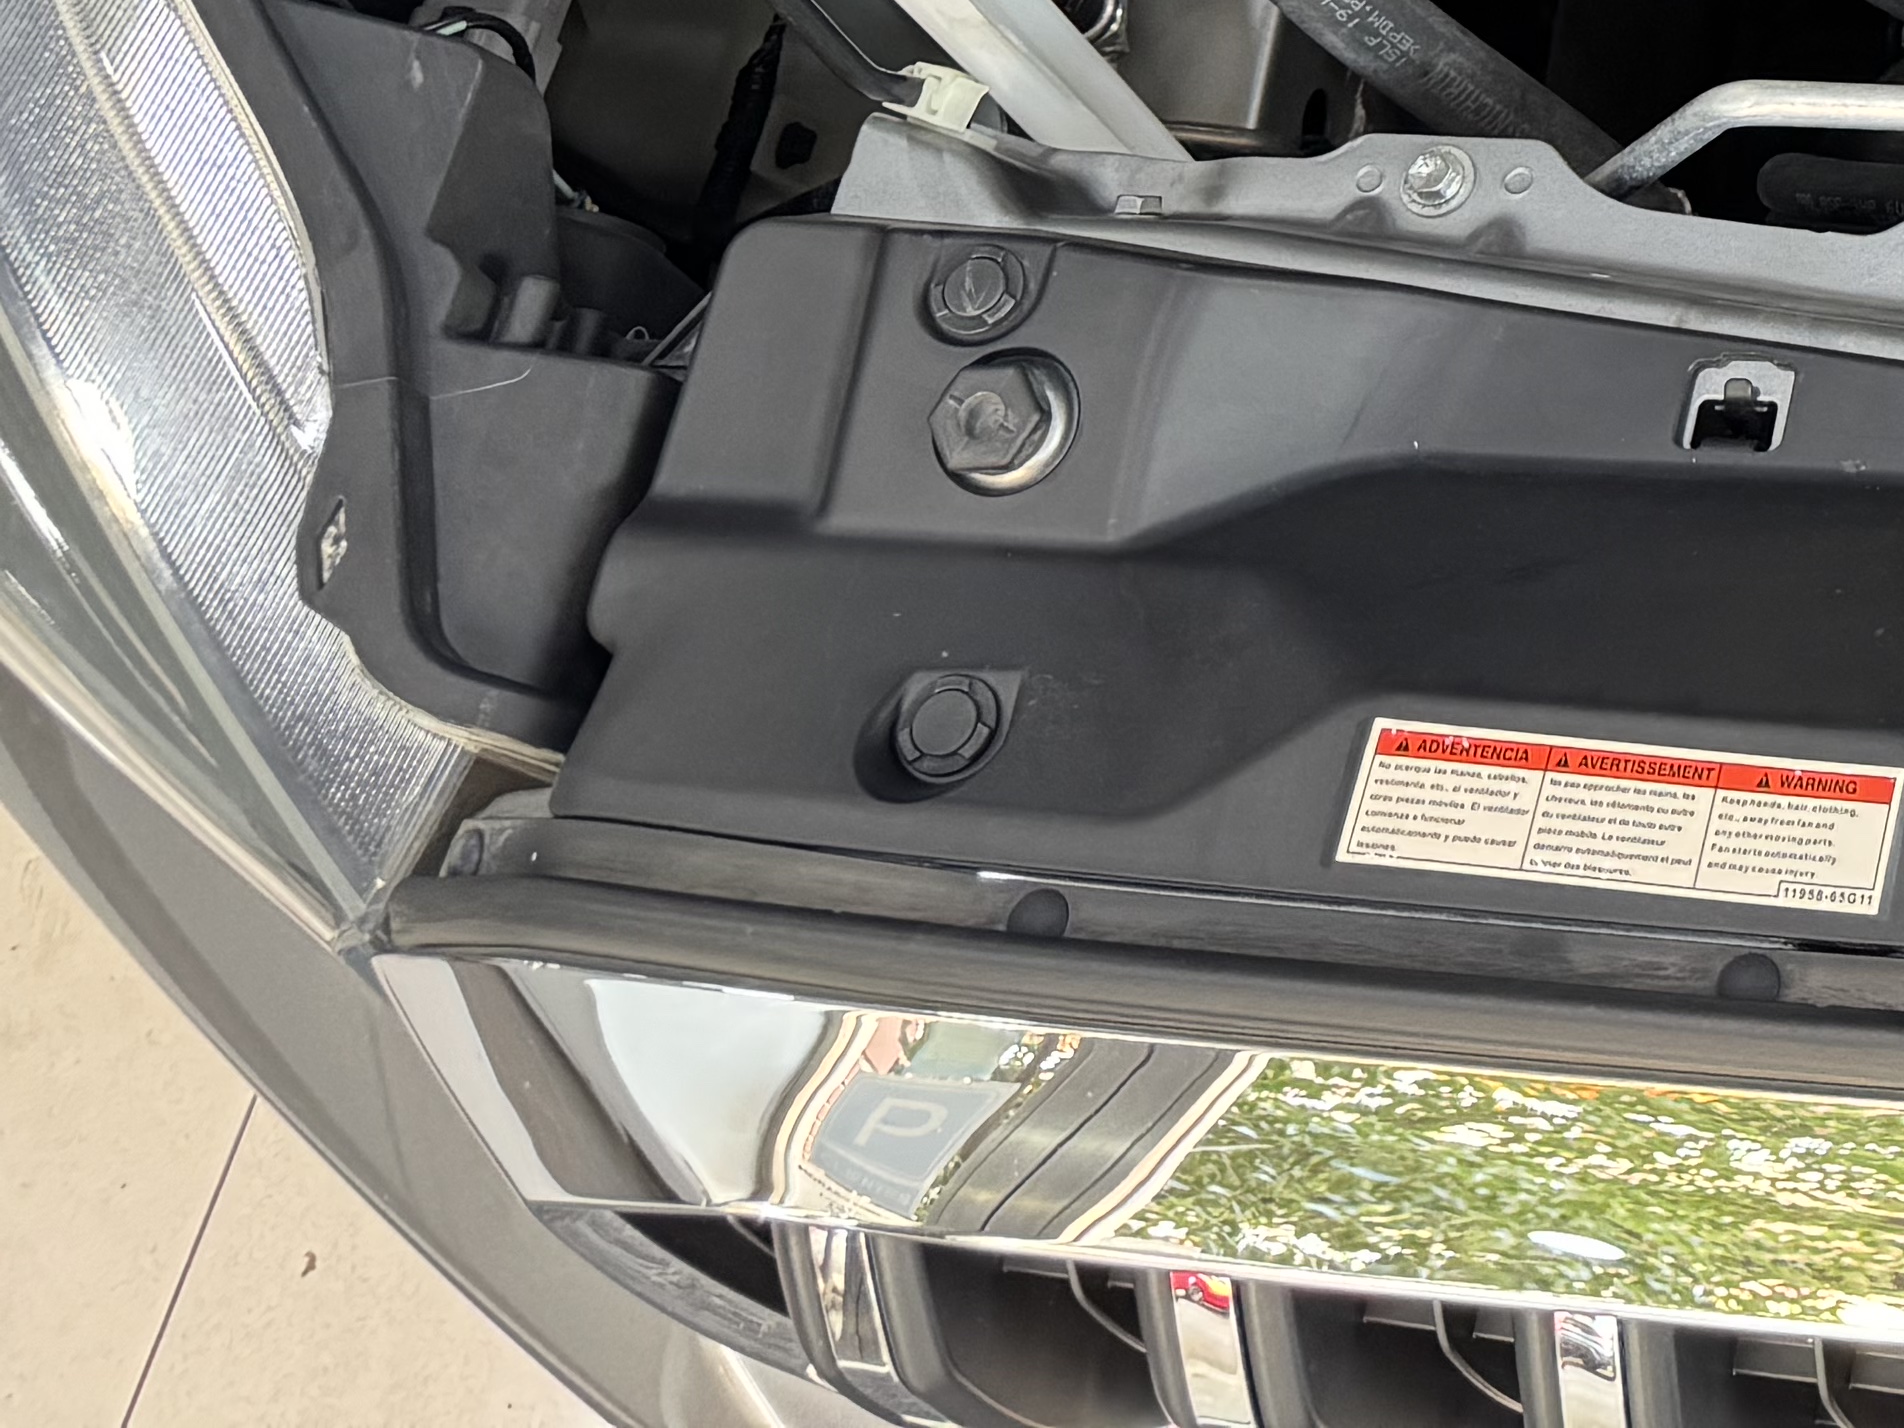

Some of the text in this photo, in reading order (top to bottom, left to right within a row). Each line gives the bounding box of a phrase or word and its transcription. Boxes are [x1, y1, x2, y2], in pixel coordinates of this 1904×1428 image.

[1417, 739, 1529, 762] ADVERTENCIA
[1578, 755, 1716, 781] AVERTISSEMENT
[1780, 773, 1857, 794] WARNING
